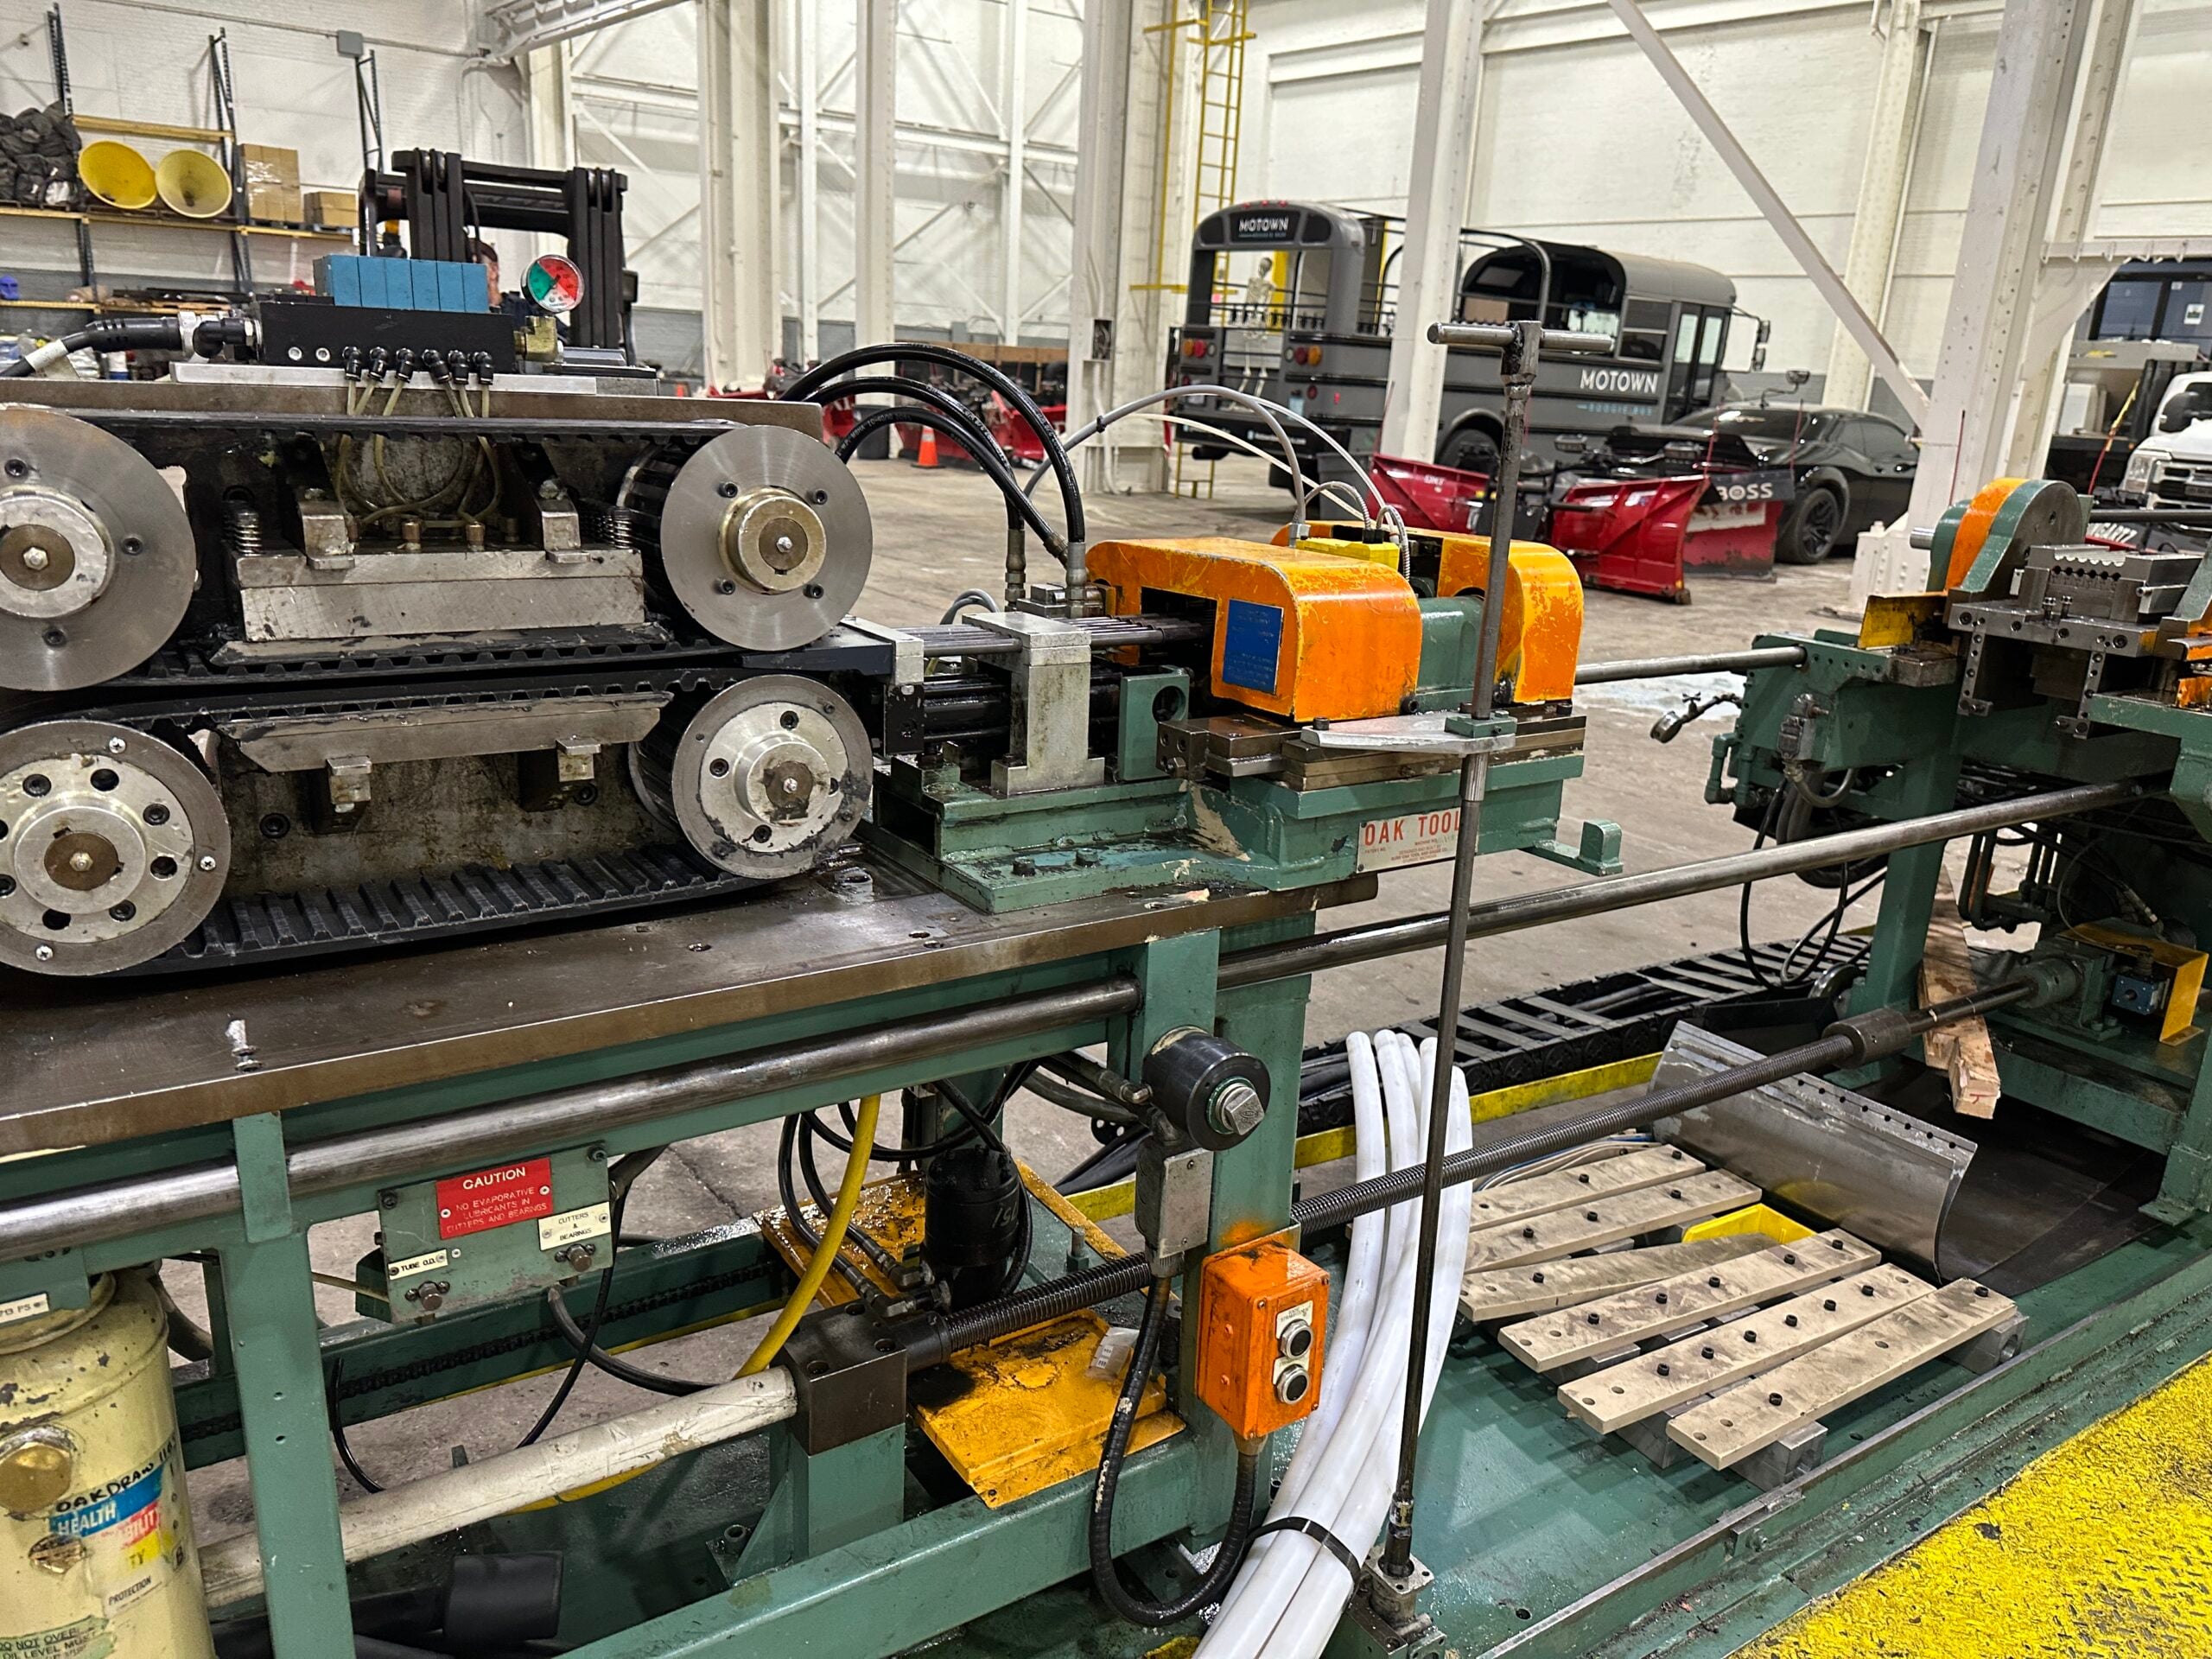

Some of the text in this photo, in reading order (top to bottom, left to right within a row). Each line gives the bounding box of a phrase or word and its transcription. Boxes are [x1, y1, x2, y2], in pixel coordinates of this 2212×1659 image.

[1238, 216, 1288, 232] MOTOWN
[1580, 369, 1658, 393] MOTOWN
[1364, 820, 1405, 846] OAK
[462, 1166, 526, 1190] CAUTION
[456, 1186, 535, 1211] NO EVAPORATIVE
[463, 1198, 530, 1220] LUBRICANTS IN
[446, 1202, 548, 1234] CUTTERS AND BEARINGS
[558, 1211, 589, 1224] CUTTERS
[559, 1227, 593, 1242] BEARINGS
[400, 1261, 420, 1272] TUBE
[56, 1463, 154, 1512] OAKDRAW
[57, 1500, 118, 1535] HEALTH
[108, 1575, 152, 1605] PROTECTION
[16, 1638, 41, 1650] NOT
[24, 1645, 60, 1659] LEVEL
